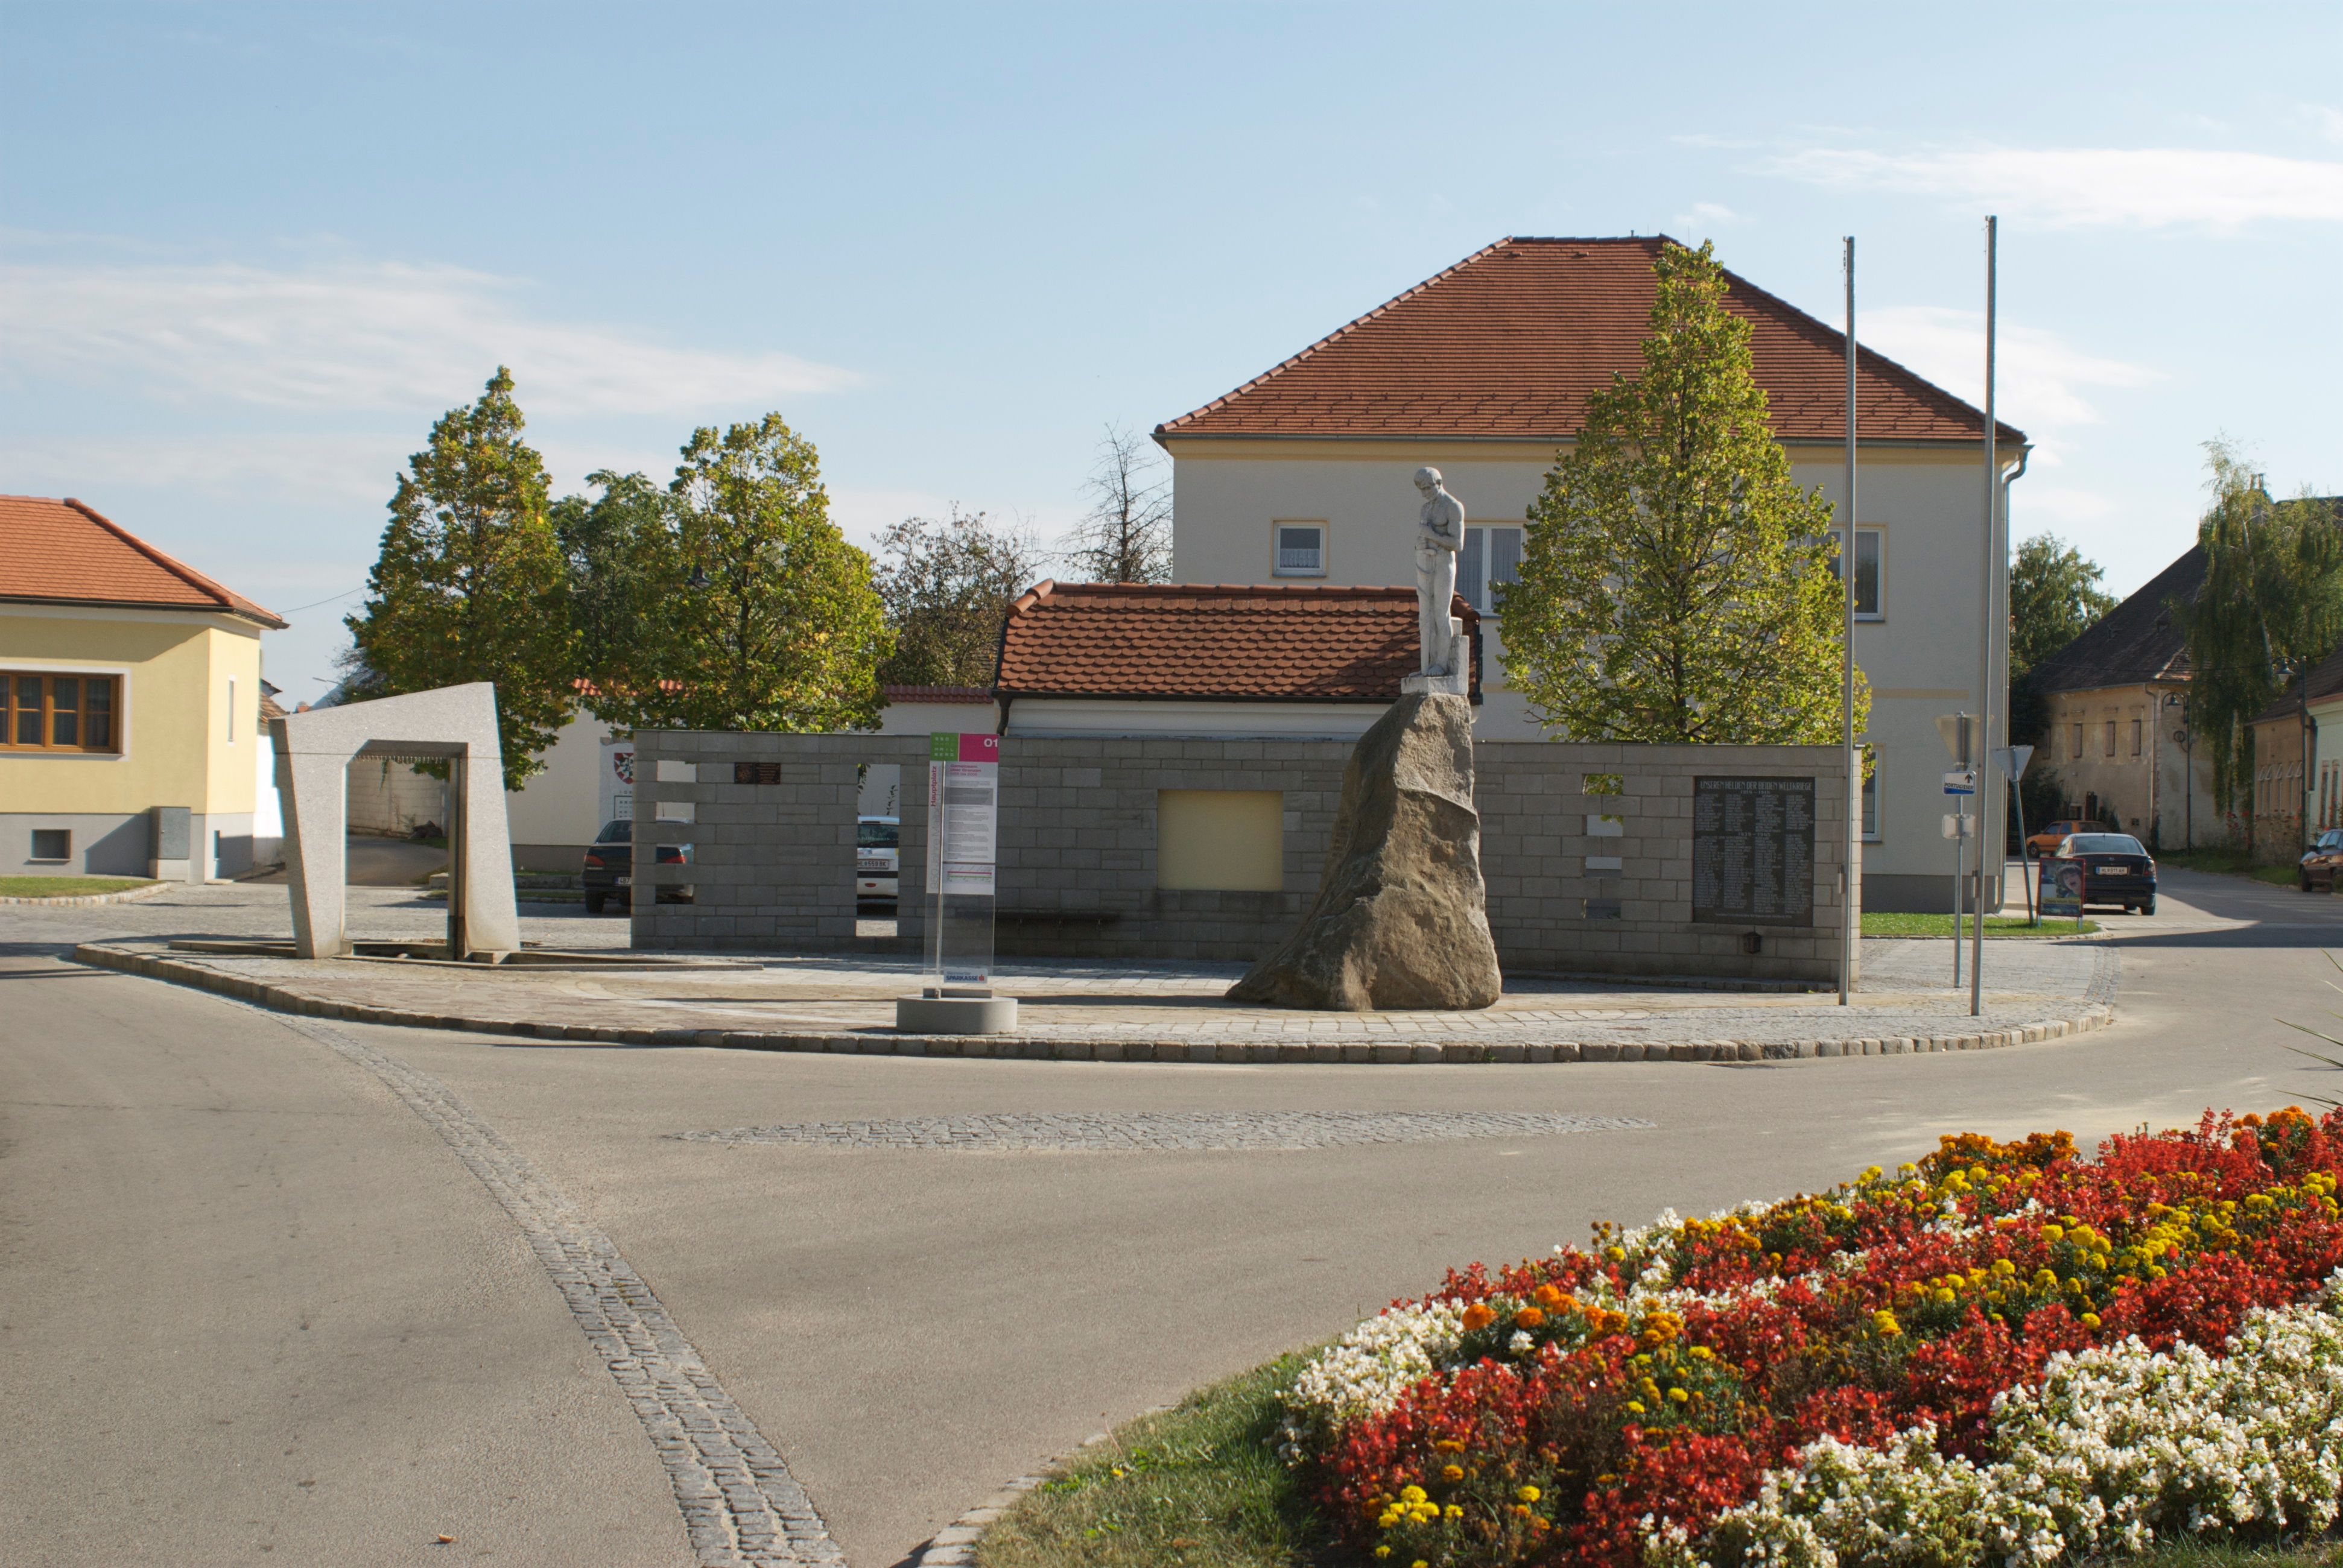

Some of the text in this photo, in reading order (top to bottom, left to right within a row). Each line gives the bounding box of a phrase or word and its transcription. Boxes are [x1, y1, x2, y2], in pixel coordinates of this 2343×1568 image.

[983, 738, 998, 748] 01
[1725, 781, 1745, 789] HELDEN
[1746, 781, 1757, 790] DER
[1758, 782, 1778, 790] BEIDEN
[1779, 782, 1813, 791] WELTKRIEGE
